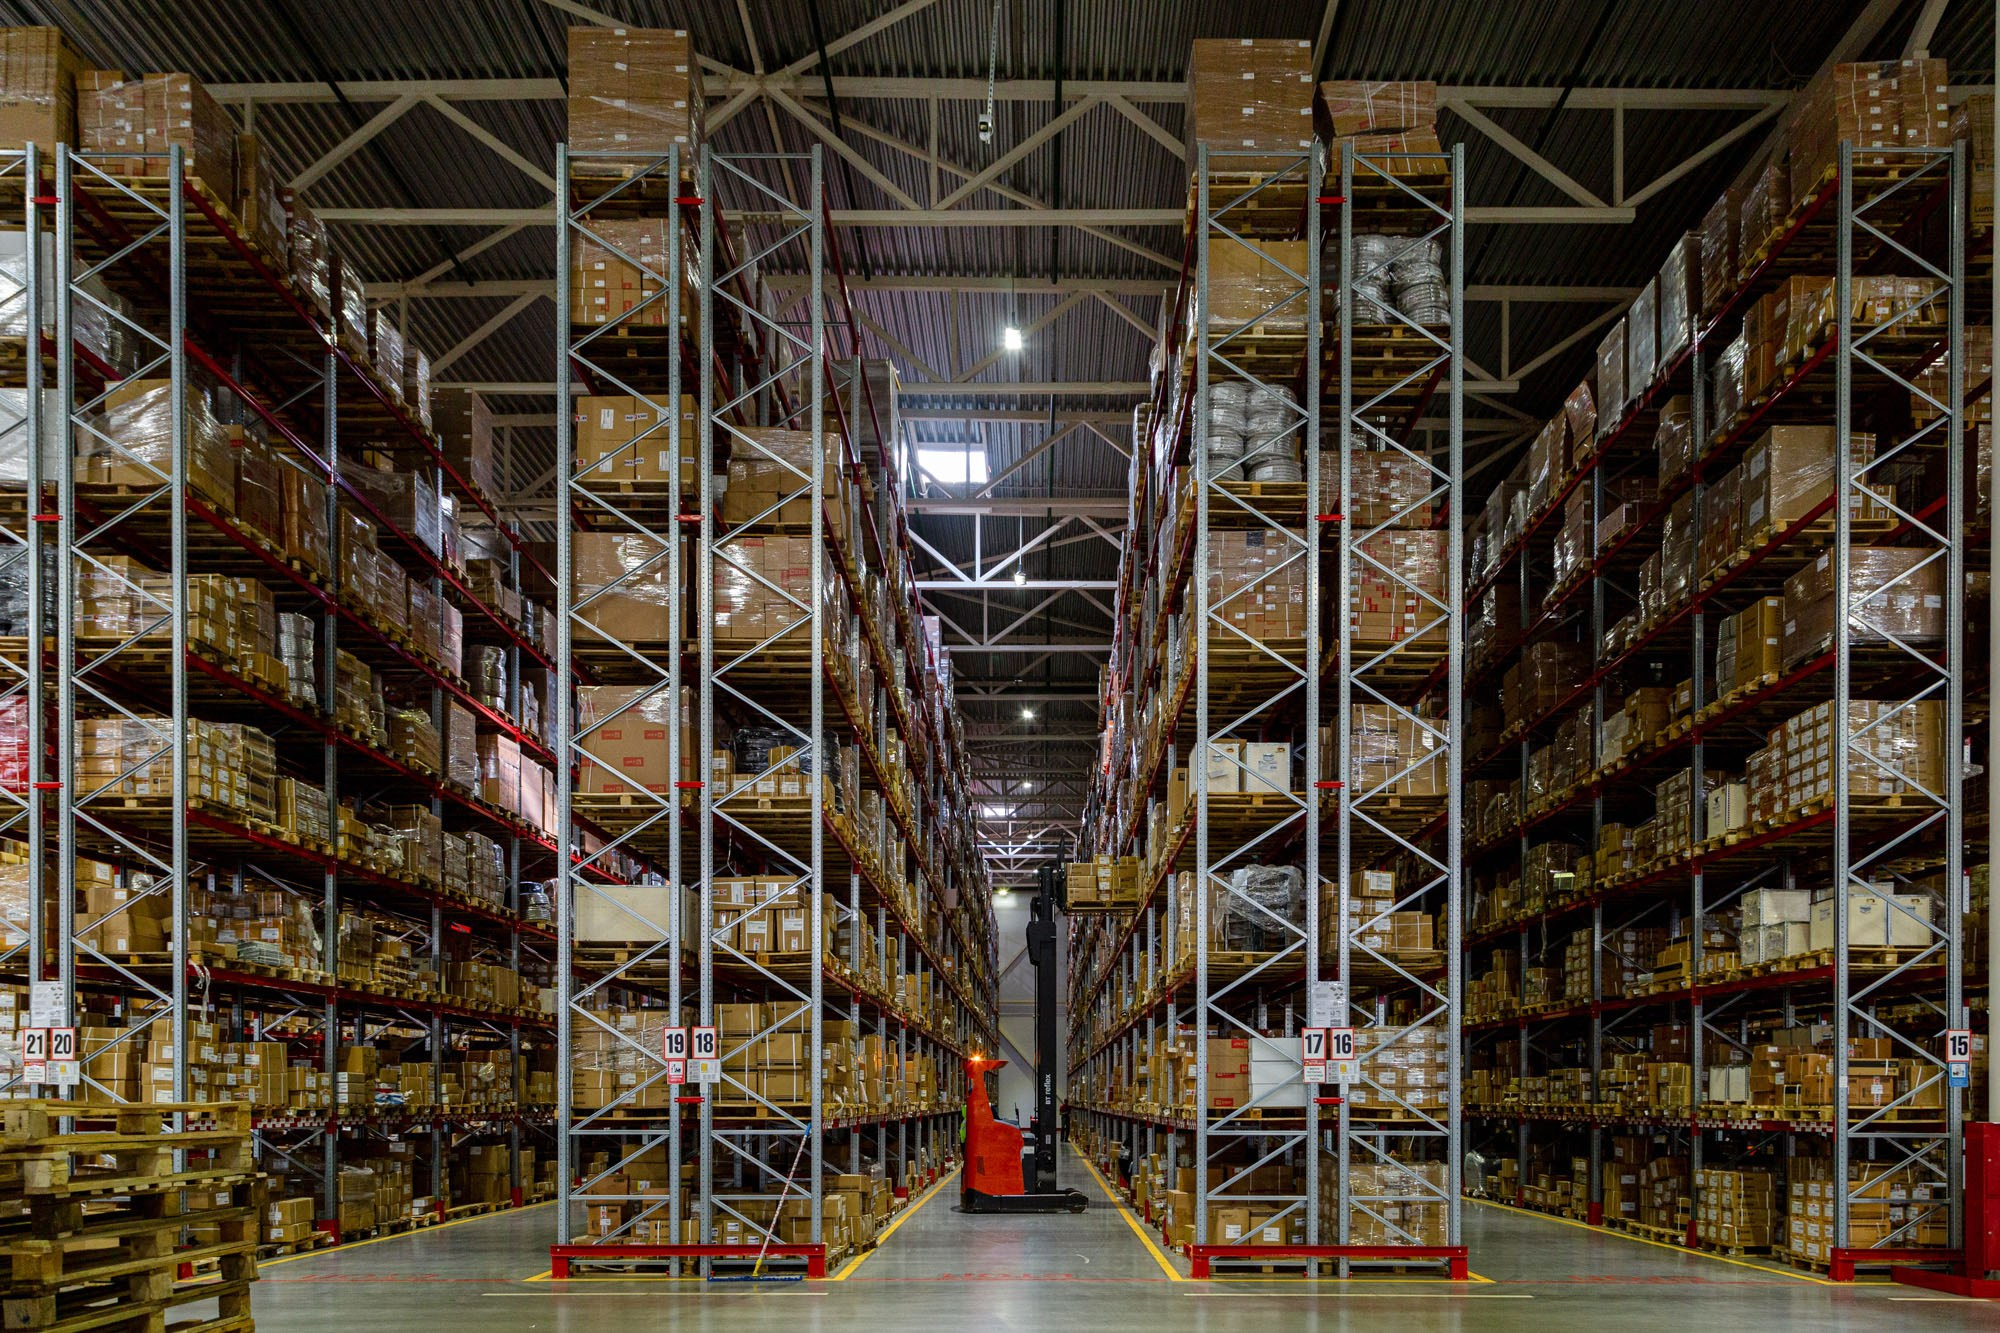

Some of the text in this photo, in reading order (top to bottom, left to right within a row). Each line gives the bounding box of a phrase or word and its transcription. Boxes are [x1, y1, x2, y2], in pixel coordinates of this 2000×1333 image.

[27, 1034, 43, 1054] 21
[54, 1034, 72, 1054] 20
[666, 1033, 684, 1054] 19
[695, 1033, 714, 1053] 18
[1305, 1034, 1323, 1054] 17
[1333, 1034, 1352, 1054] 16
[1949, 1035, 1968, 1056] 15
[1045, 1096, 1051, 1105] BT
